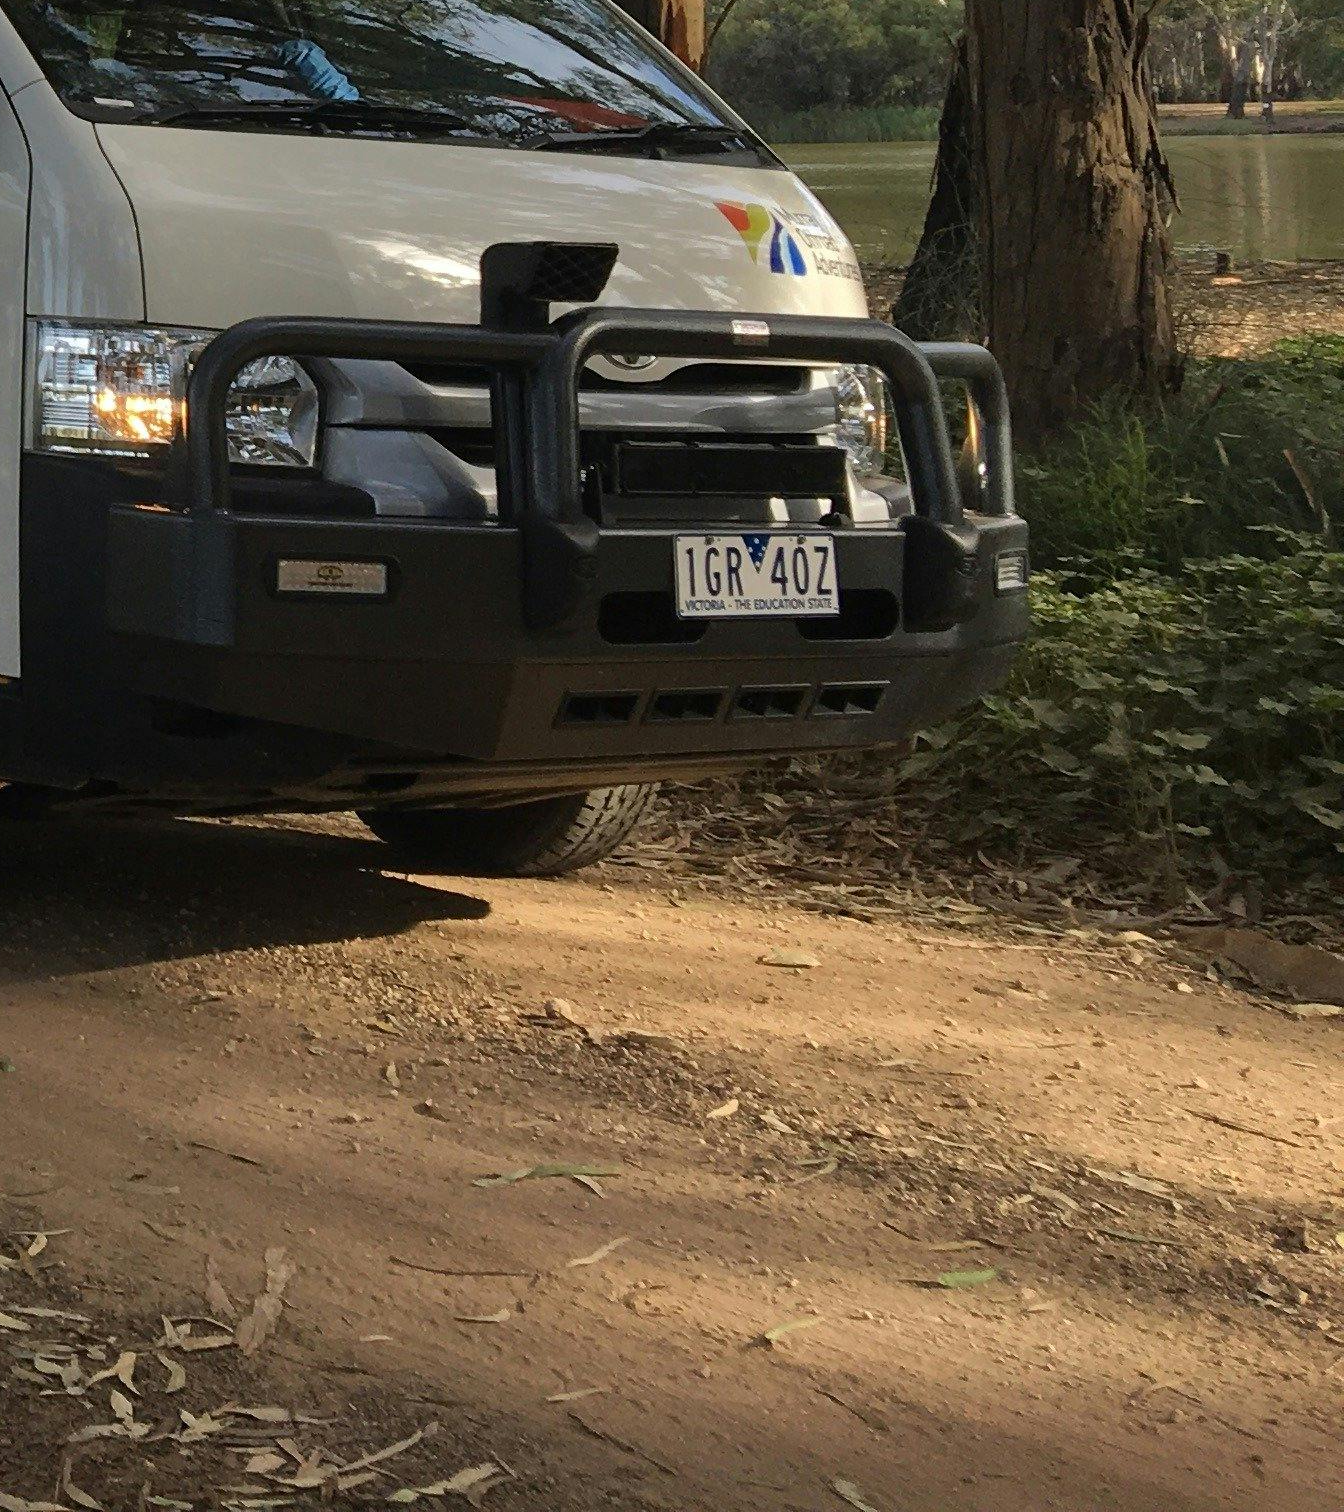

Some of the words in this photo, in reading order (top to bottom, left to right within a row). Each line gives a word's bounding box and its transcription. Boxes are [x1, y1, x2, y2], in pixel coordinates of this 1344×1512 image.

[686, 546, 744, 597] 1GR
[685, 600, 726, 611] VICTORIA
[734, 599, 752, 610] THE
[754, 598, 805, 610] EDUCATION
[807, 598, 832, 609] STATE
